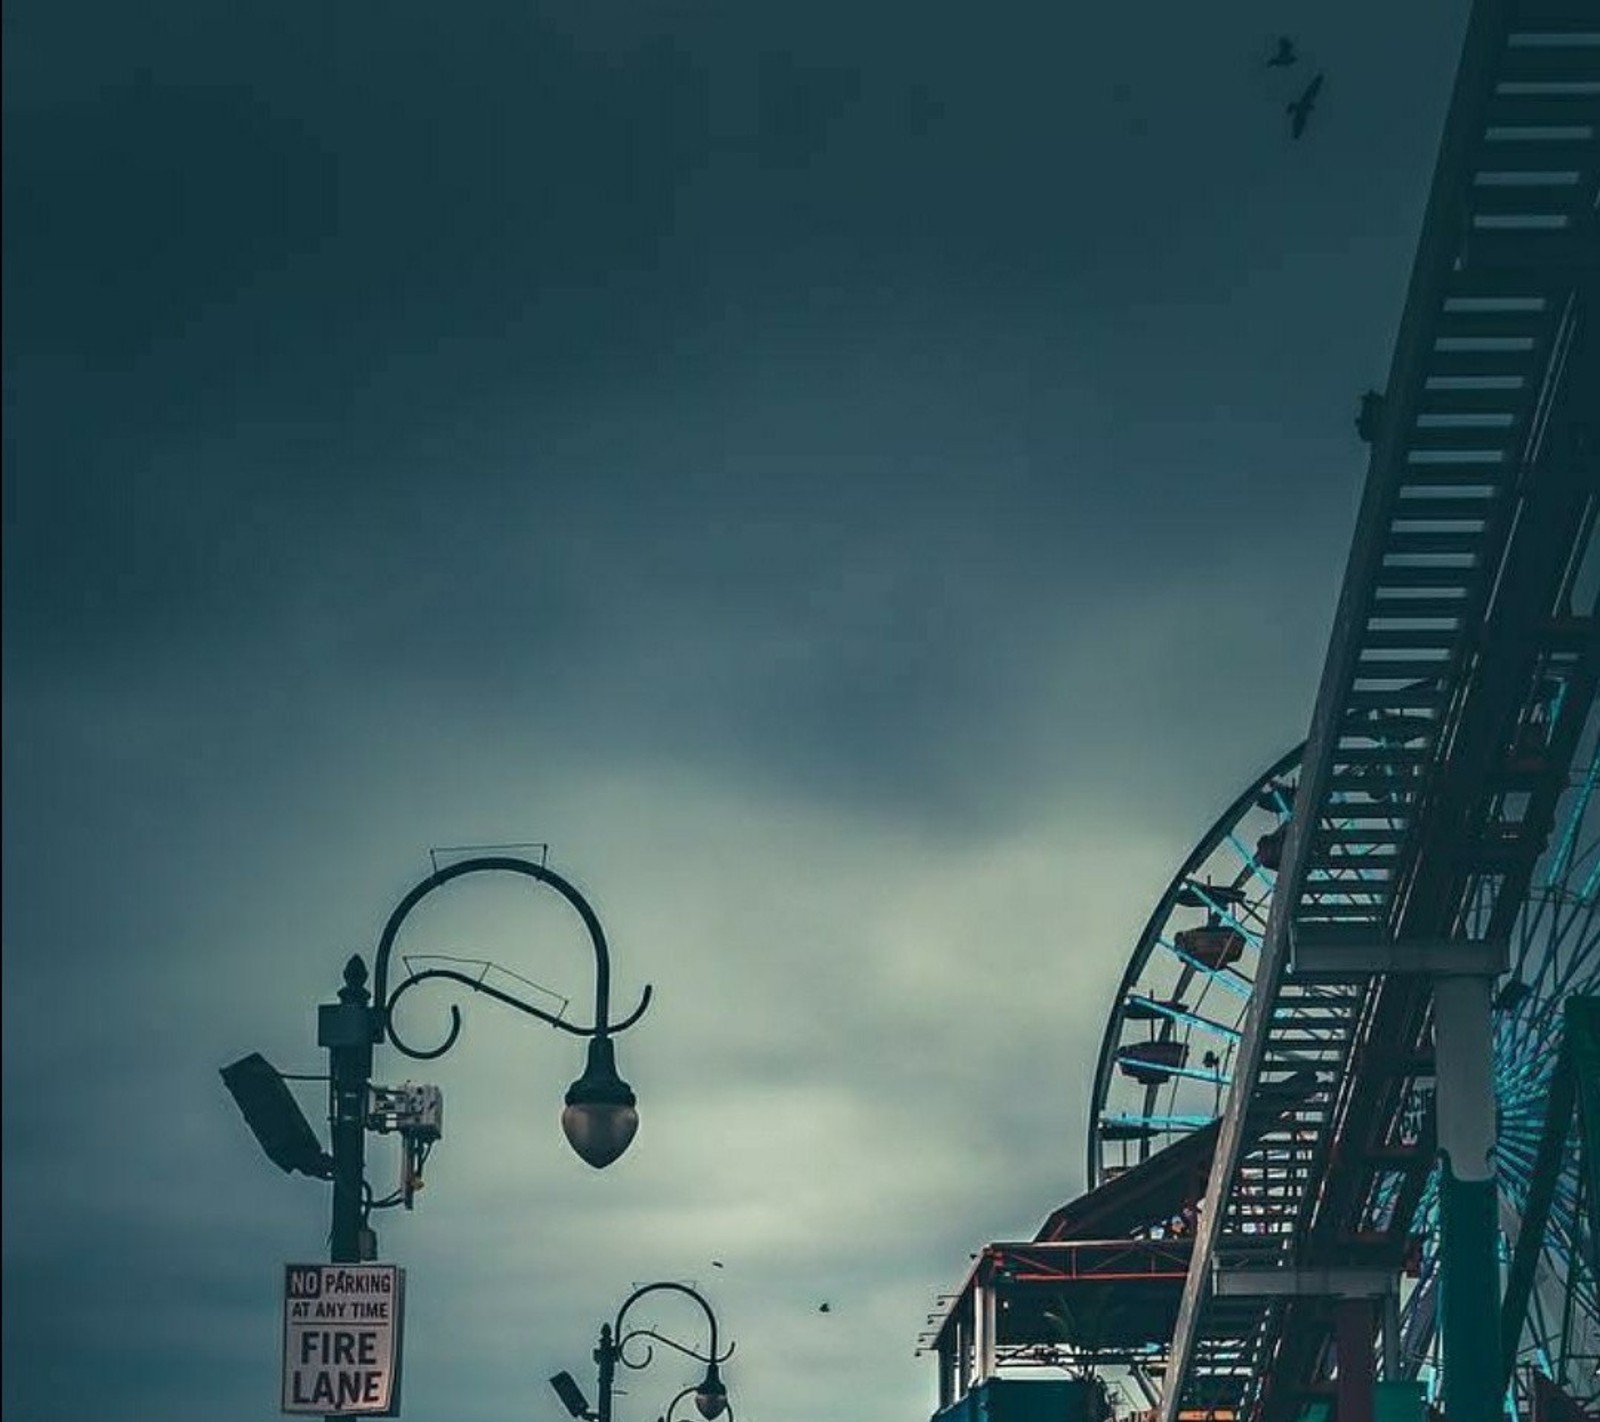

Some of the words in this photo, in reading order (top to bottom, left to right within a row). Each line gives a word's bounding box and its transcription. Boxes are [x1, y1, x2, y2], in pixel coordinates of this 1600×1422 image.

[292, 1271, 317, 1294] NO
[326, 1274, 391, 1294] PARKING
[292, 1302, 311, 1317] AT
[316, 1303, 347, 1318] ANY
[352, 1303, 388, 1318] TIME
[301, 1331, 376, 1365] FIRE
[293, 1371, 382, 1405] LANE
